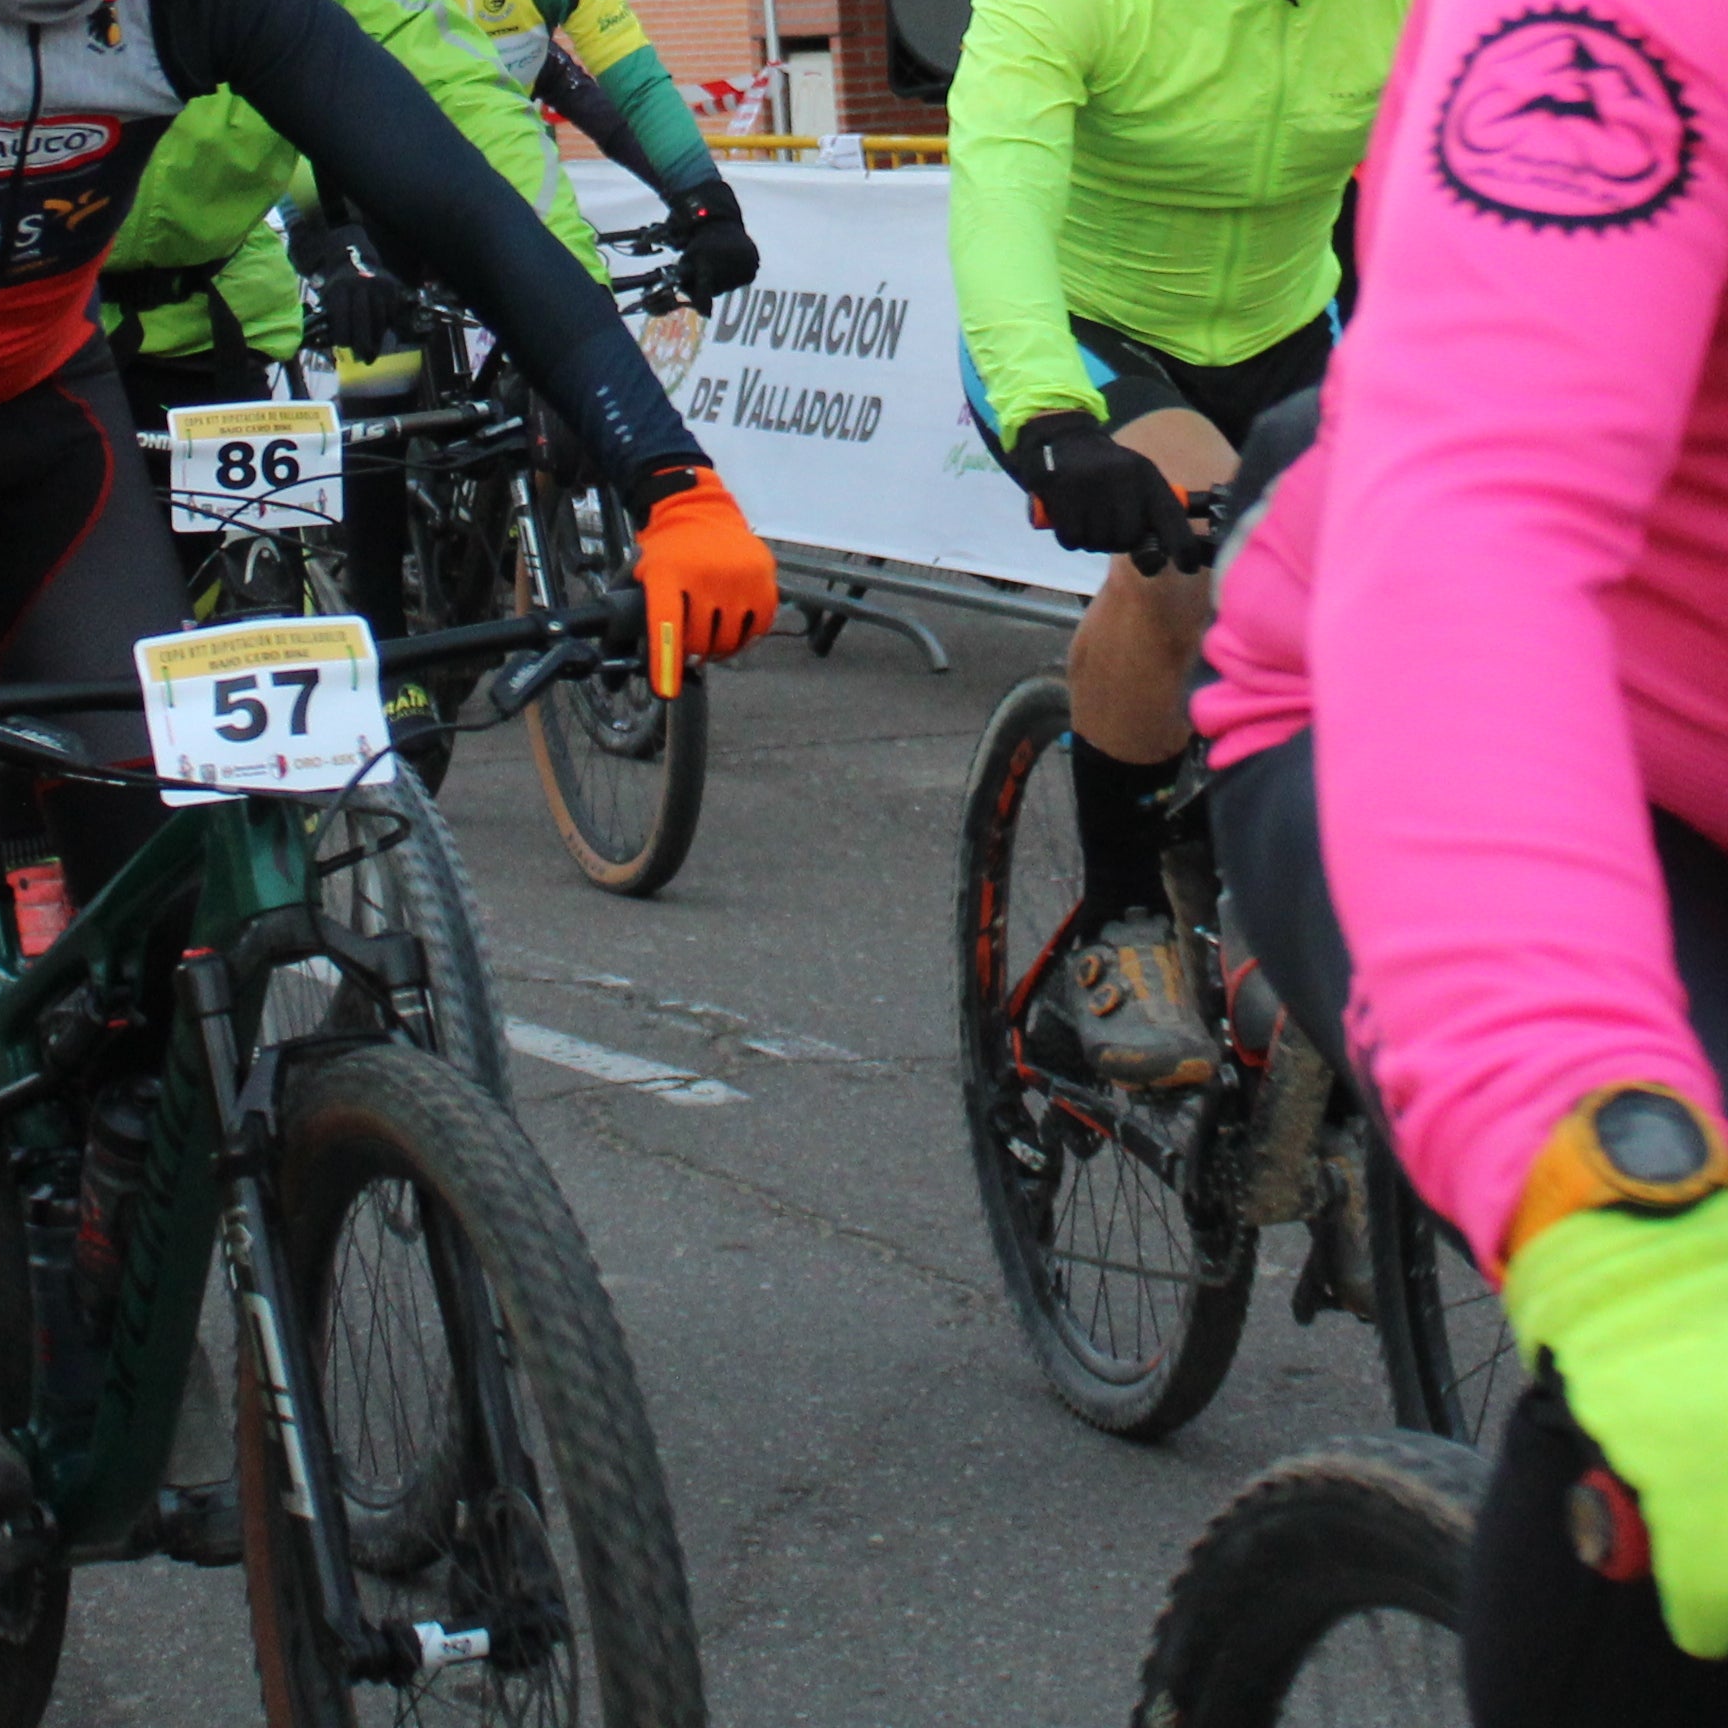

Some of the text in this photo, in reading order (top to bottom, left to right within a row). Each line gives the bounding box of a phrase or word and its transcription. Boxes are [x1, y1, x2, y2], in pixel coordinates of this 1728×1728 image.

[686, 375, 729, 424] DE
[731, 366, 883, 443] VALLADOLID
[215, 438, 300, 491] 86
[213, 667, 320, 744] 57
